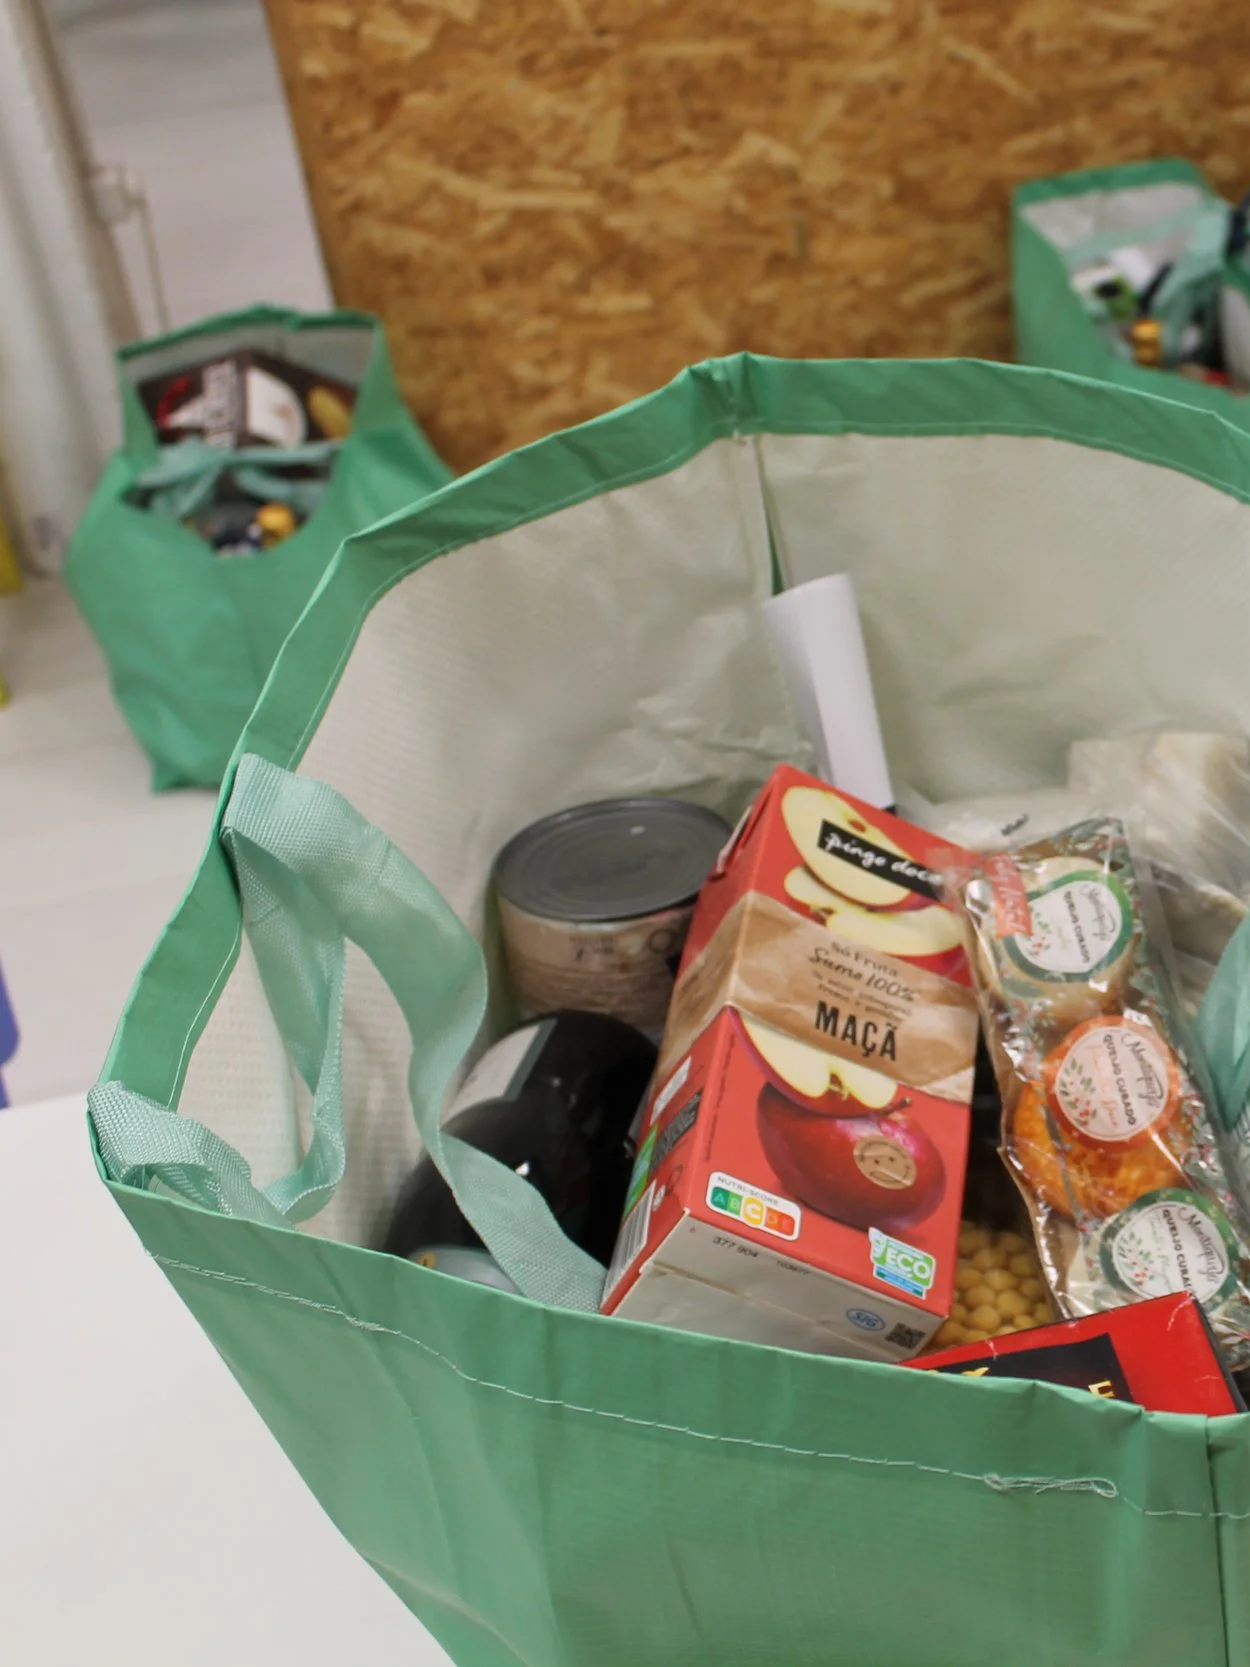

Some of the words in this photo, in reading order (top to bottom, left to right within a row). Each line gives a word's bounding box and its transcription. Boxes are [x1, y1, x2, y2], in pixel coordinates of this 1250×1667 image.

[823, 831, 886, 868] pingo
[814, 1000, 898, 1062] MAÇÃ
[1102, 1033, 1122, 1076] QUEIJO
[1114, 1075, 1137, 1127] CURADO
[745, 1200, 762, 1220] C
[1161, 1207, 1183, 1251] QUEIJO
[1174, 1251, 1192, 1289] CURA
